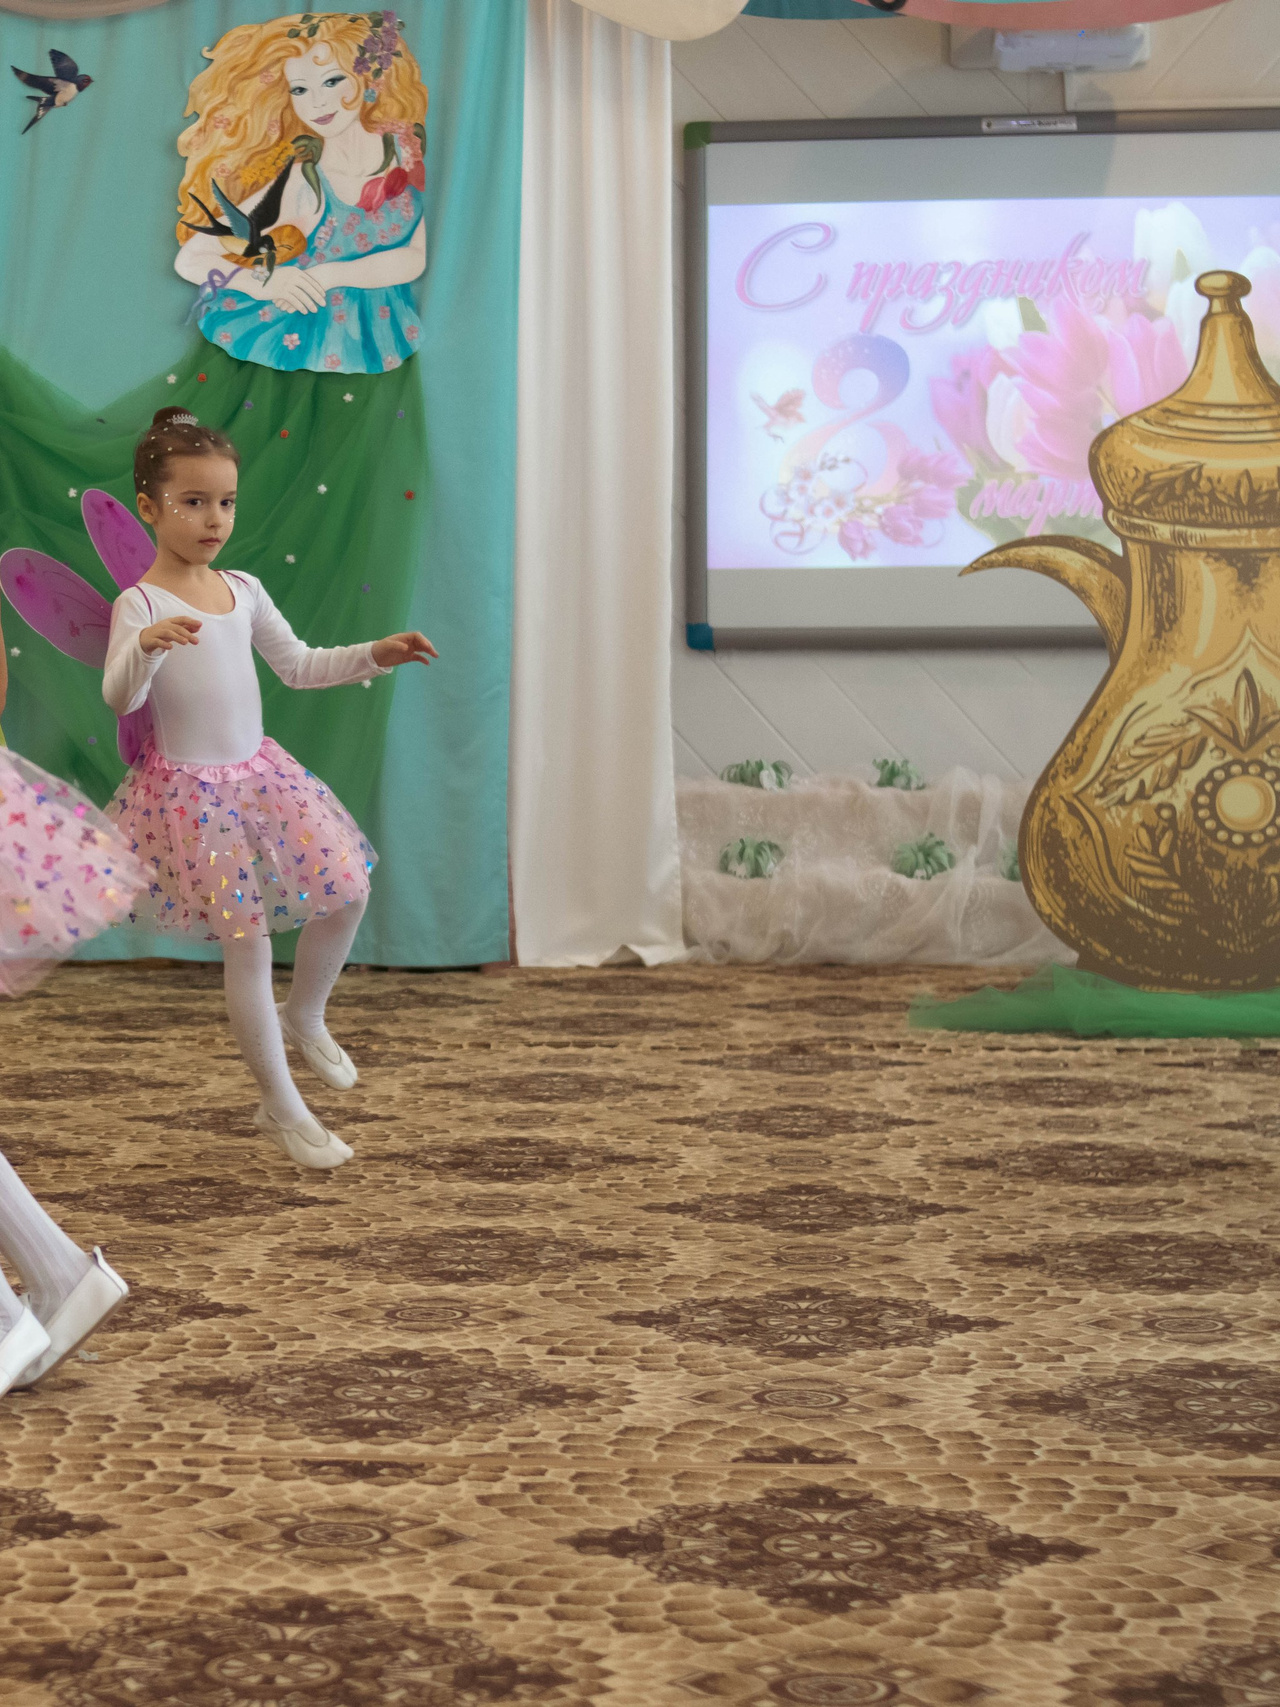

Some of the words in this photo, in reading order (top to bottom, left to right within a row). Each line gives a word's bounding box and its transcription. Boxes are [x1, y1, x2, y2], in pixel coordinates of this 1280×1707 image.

[734, 221, 834, 312] С
[844, 230, 1151, 335] праздником
[777, 332, 916, 508] 8
[969, 479, 1104, 537] март
